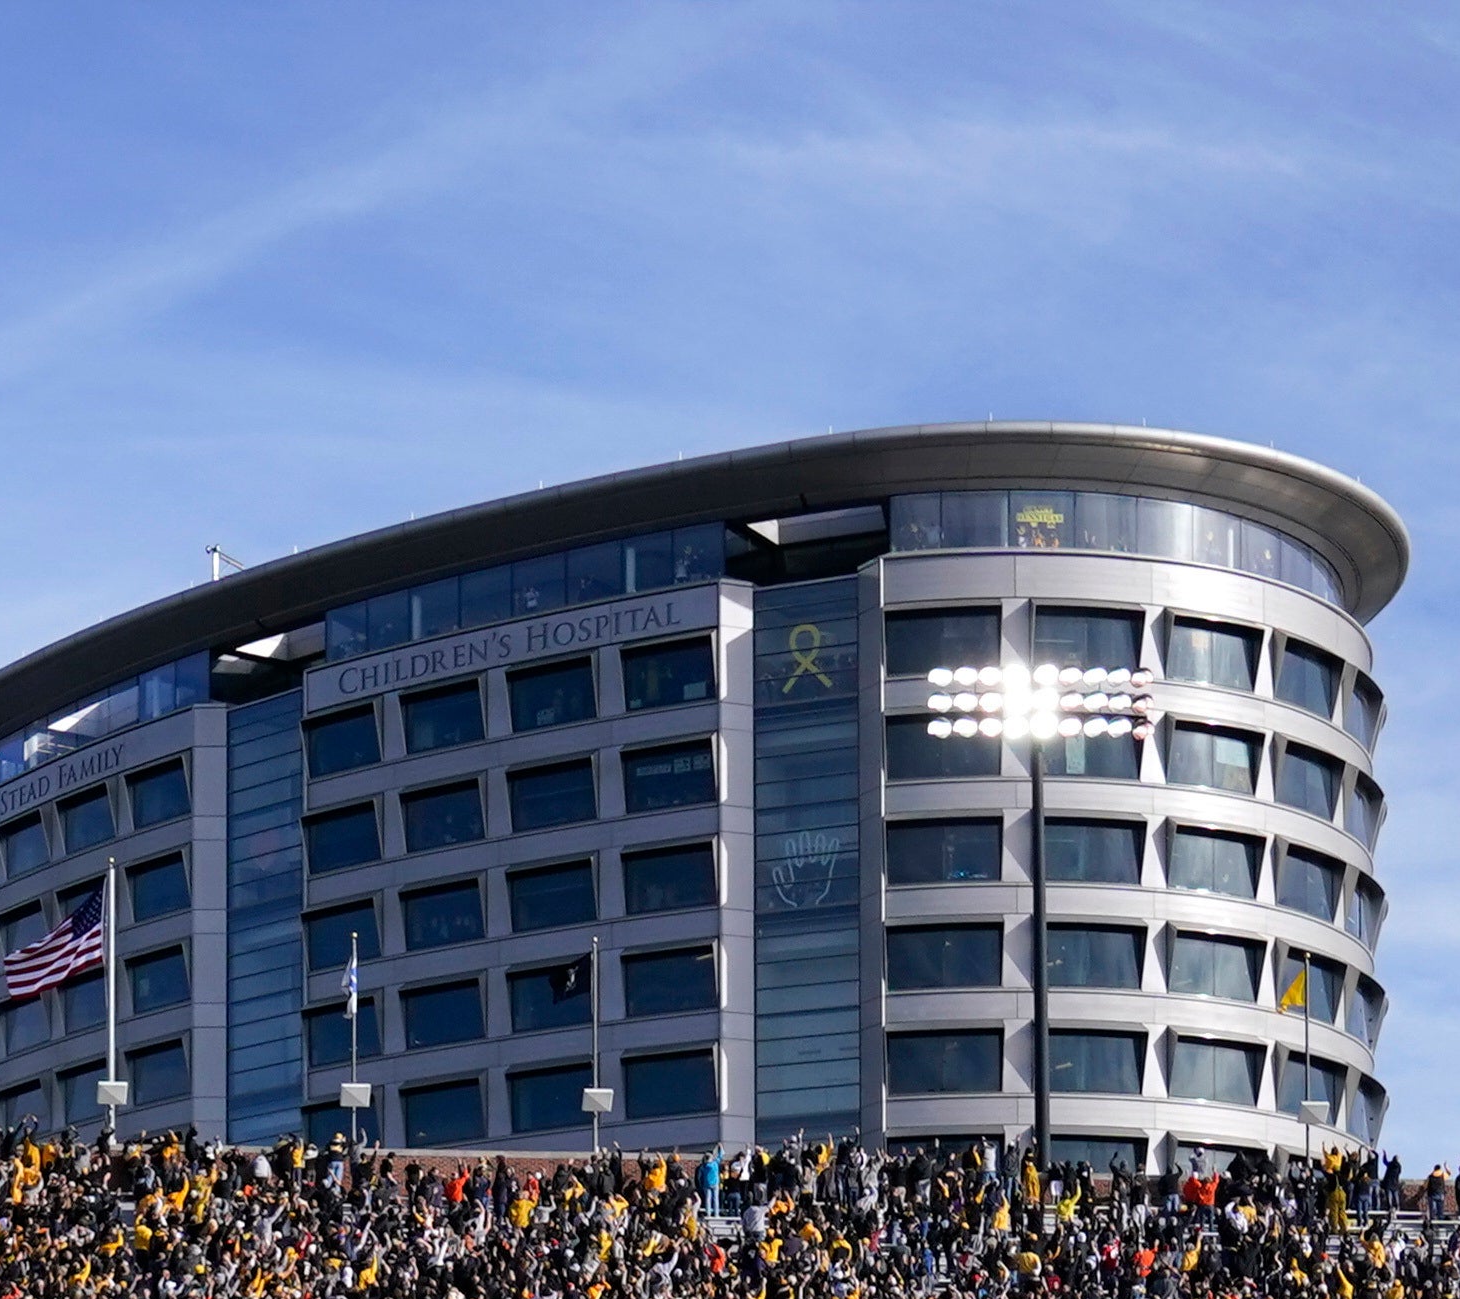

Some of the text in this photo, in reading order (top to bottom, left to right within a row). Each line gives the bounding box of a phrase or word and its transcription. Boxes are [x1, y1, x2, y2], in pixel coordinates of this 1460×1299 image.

[338, 602, 681, 695] CHILDREN'S HOSPITAL
[0, 744, 124, 815] STEAD FAMILY
